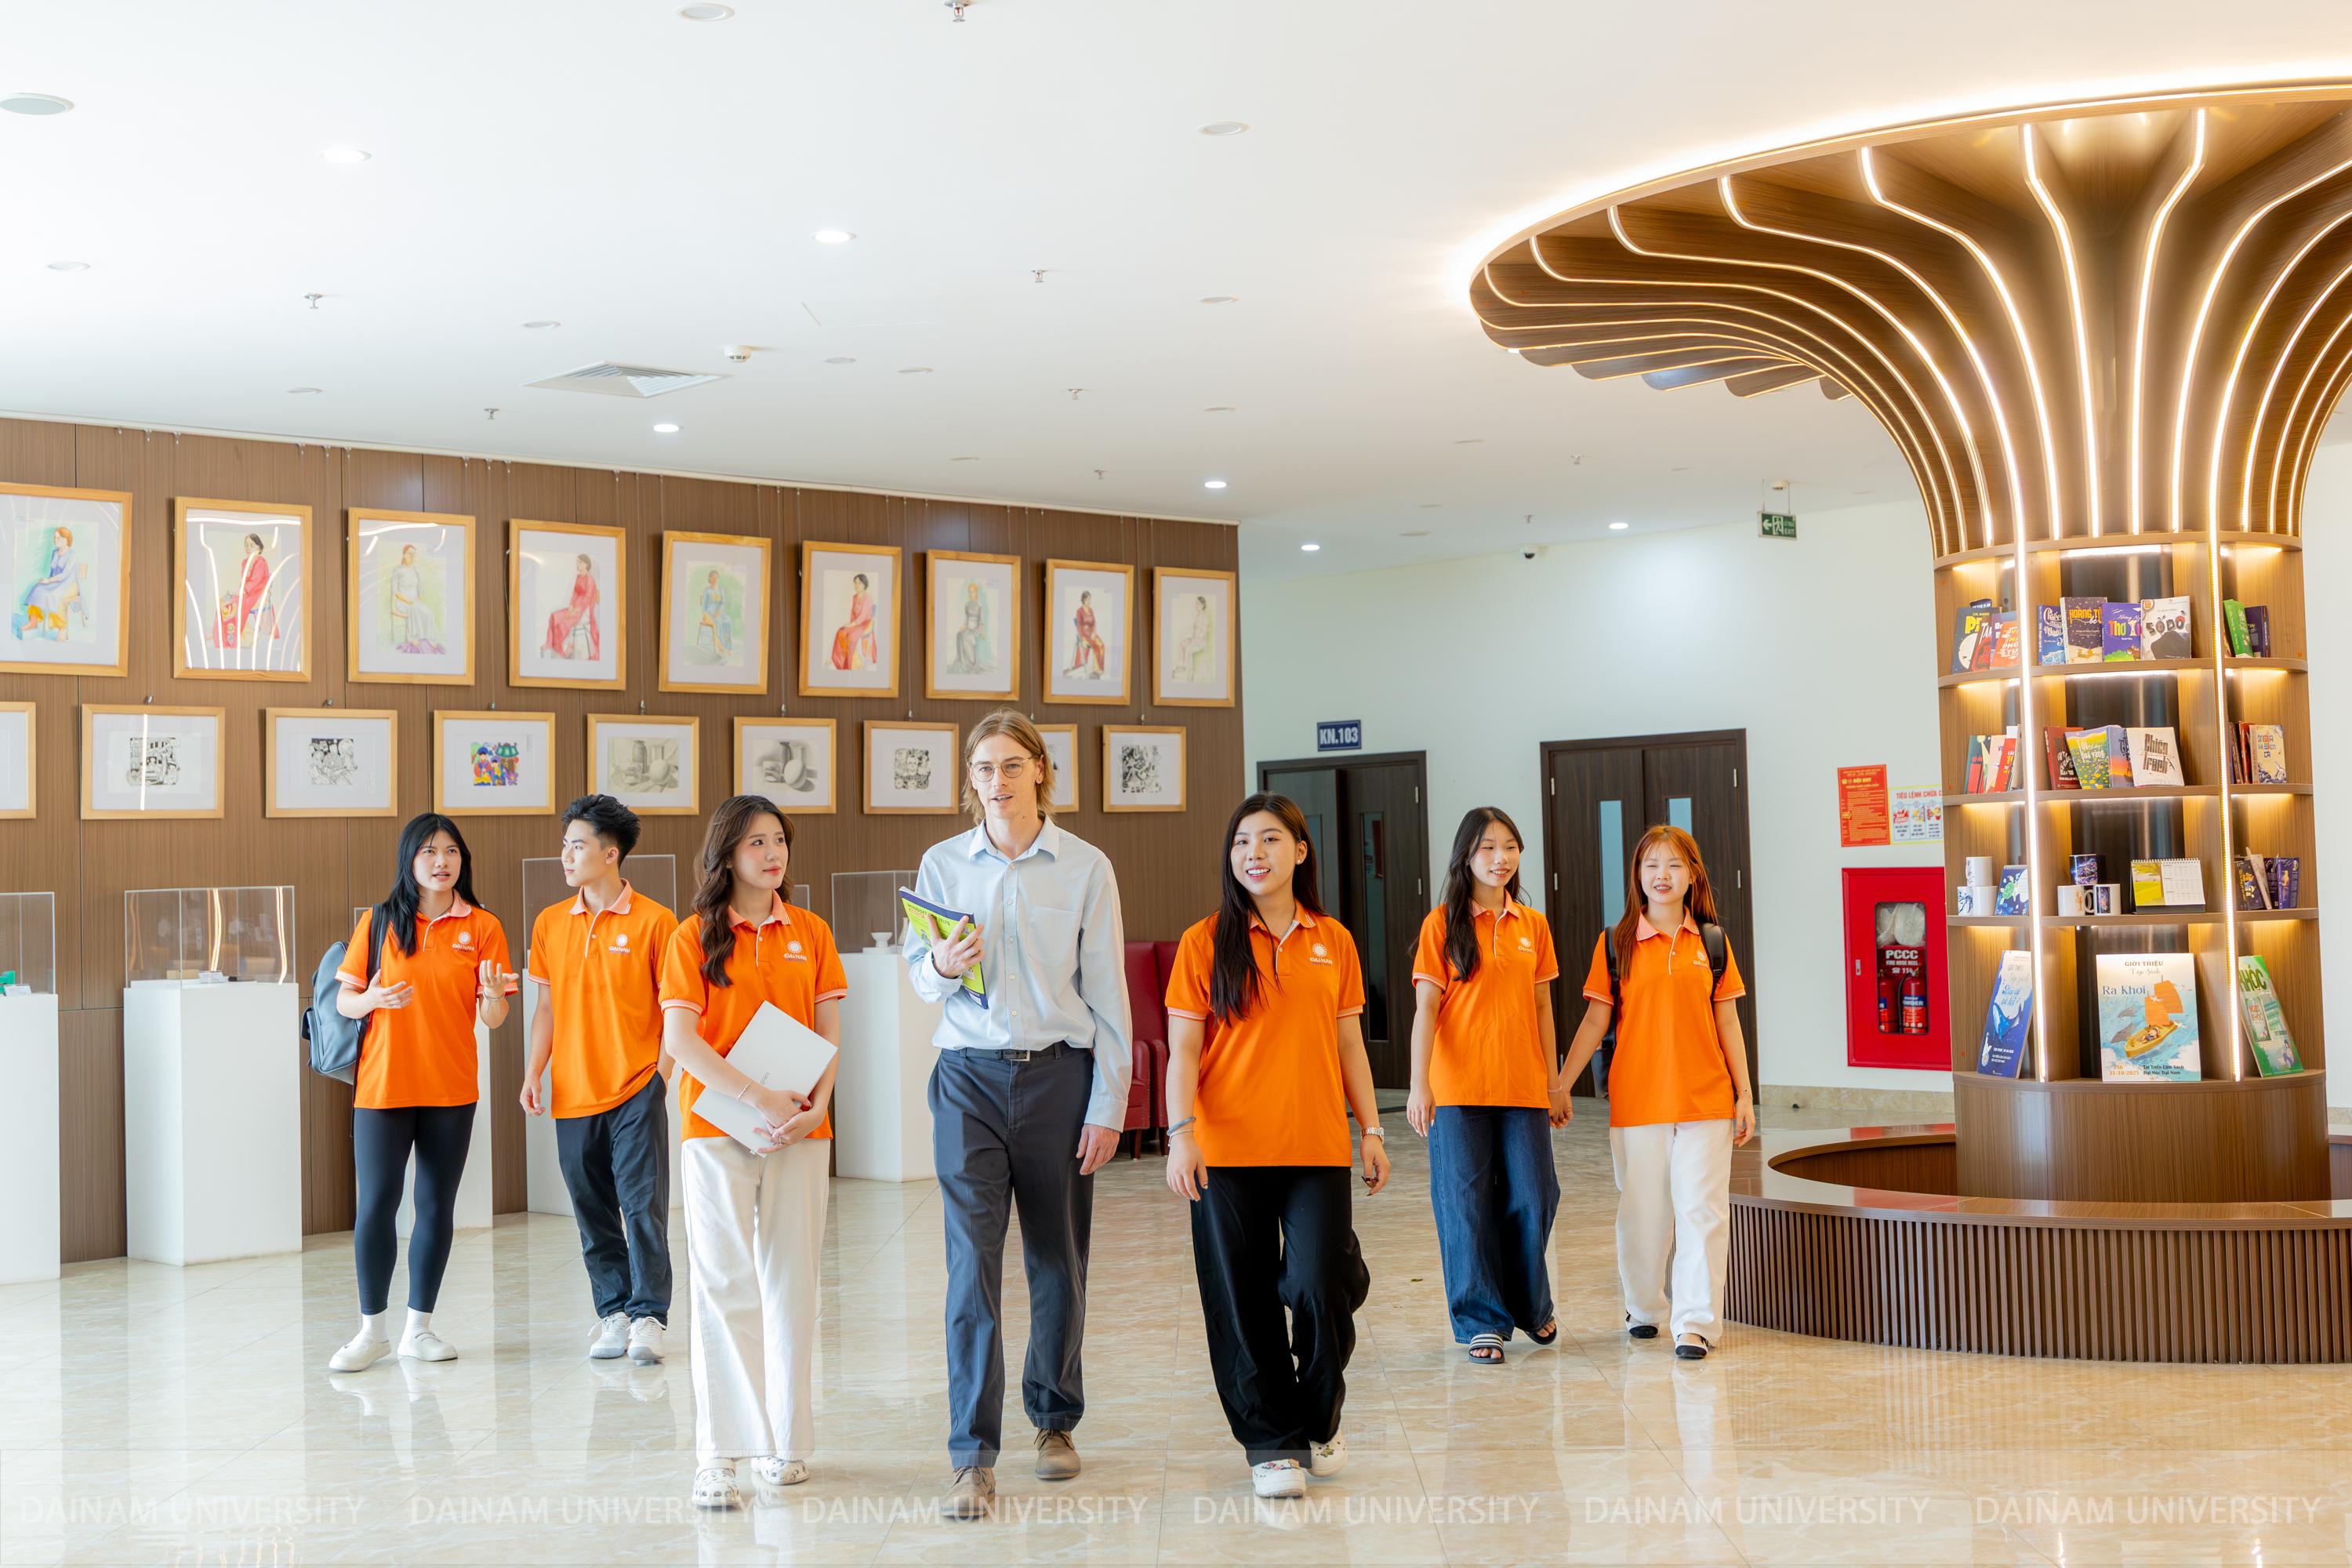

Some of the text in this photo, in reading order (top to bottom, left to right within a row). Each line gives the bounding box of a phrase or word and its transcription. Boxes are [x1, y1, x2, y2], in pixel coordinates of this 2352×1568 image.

[1319, 726, 1359, 745] KN.103
[1886, 949, 1918, 960] PCCC
[2103, 985, 2146, 995] Ra Khơi
